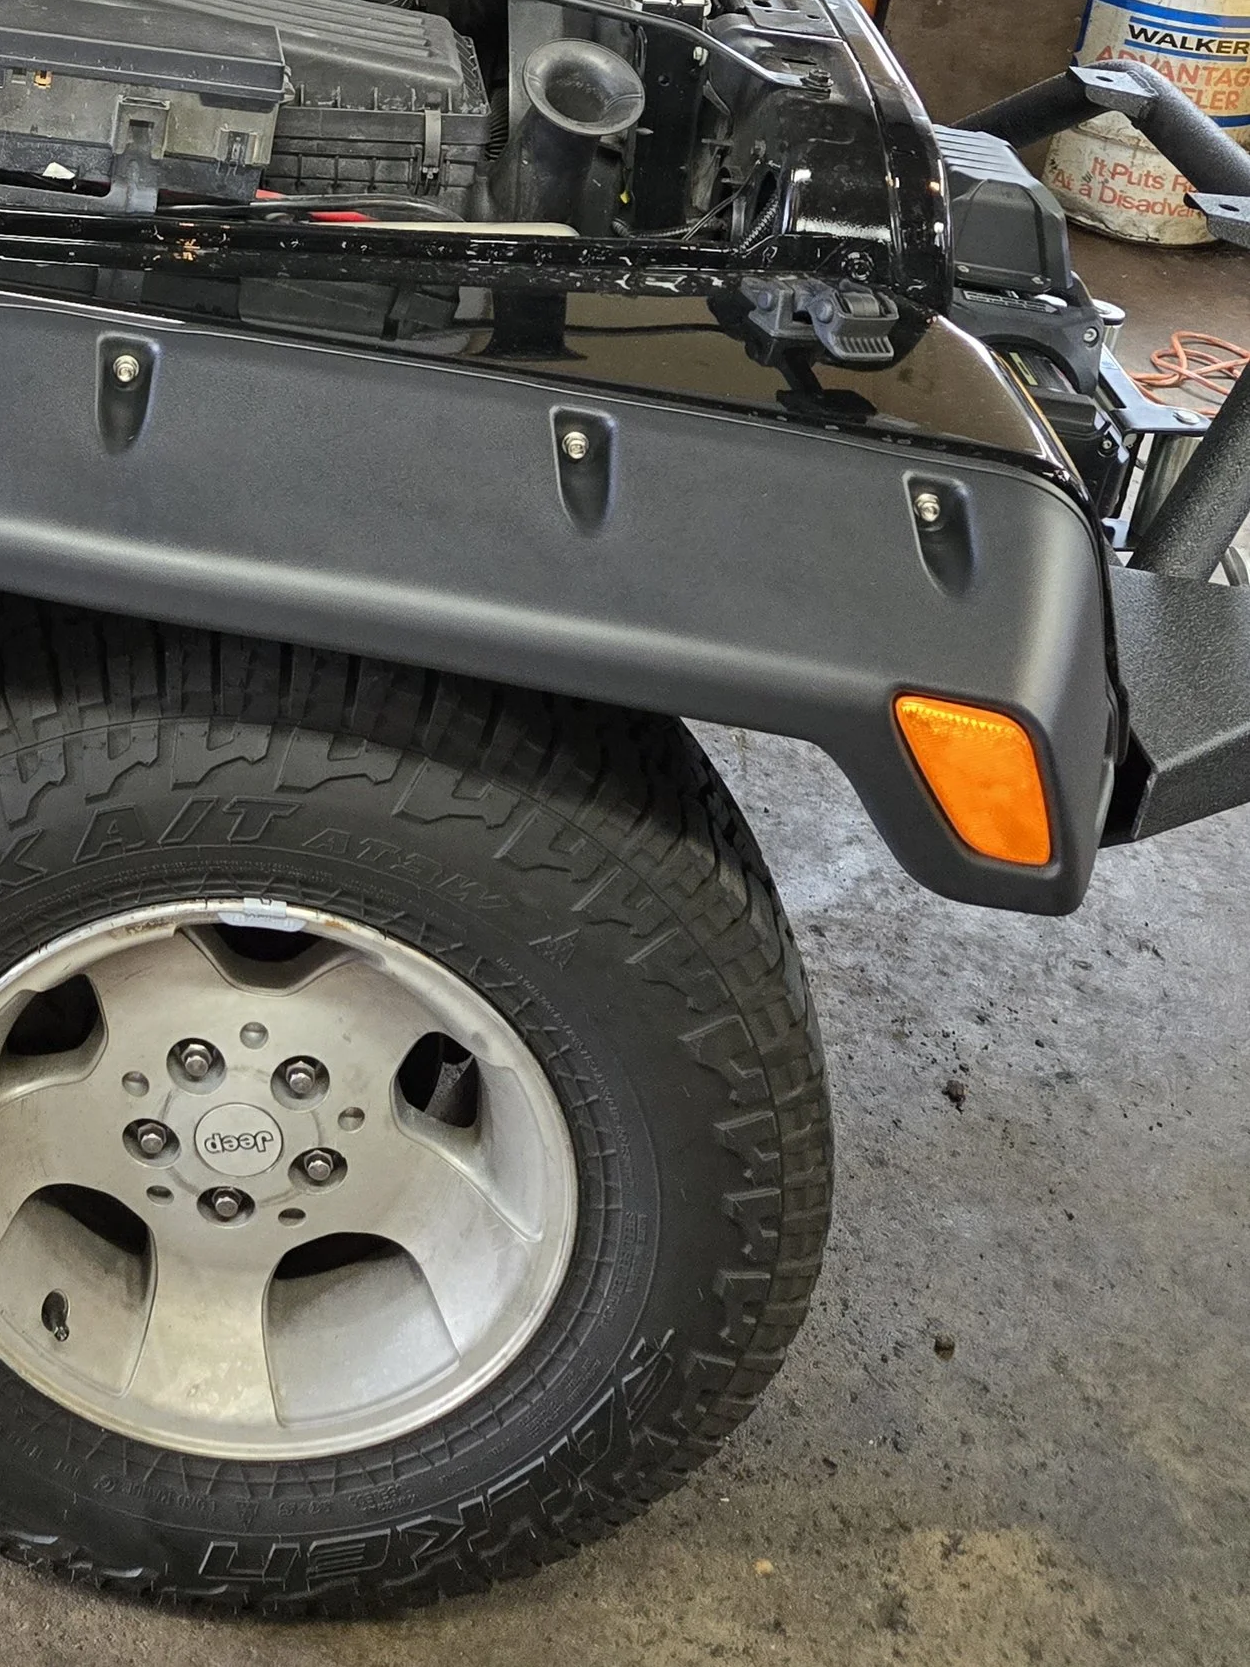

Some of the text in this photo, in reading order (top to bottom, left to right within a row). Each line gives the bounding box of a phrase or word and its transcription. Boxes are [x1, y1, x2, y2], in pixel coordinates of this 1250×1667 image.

[1128, 24, 1250, 55] WALKER
[1052, 168, 1075, 192] At
[1079, 185, 1093, 200] a
[1090, 156, 1106, 178] It
[1109, 162, 1165, 191] Puts
[73, 795, 304, 864] A/T
[203, 1130, 274, 1154] Jeep
[197, 1327, 675, 1593] FALKEN
